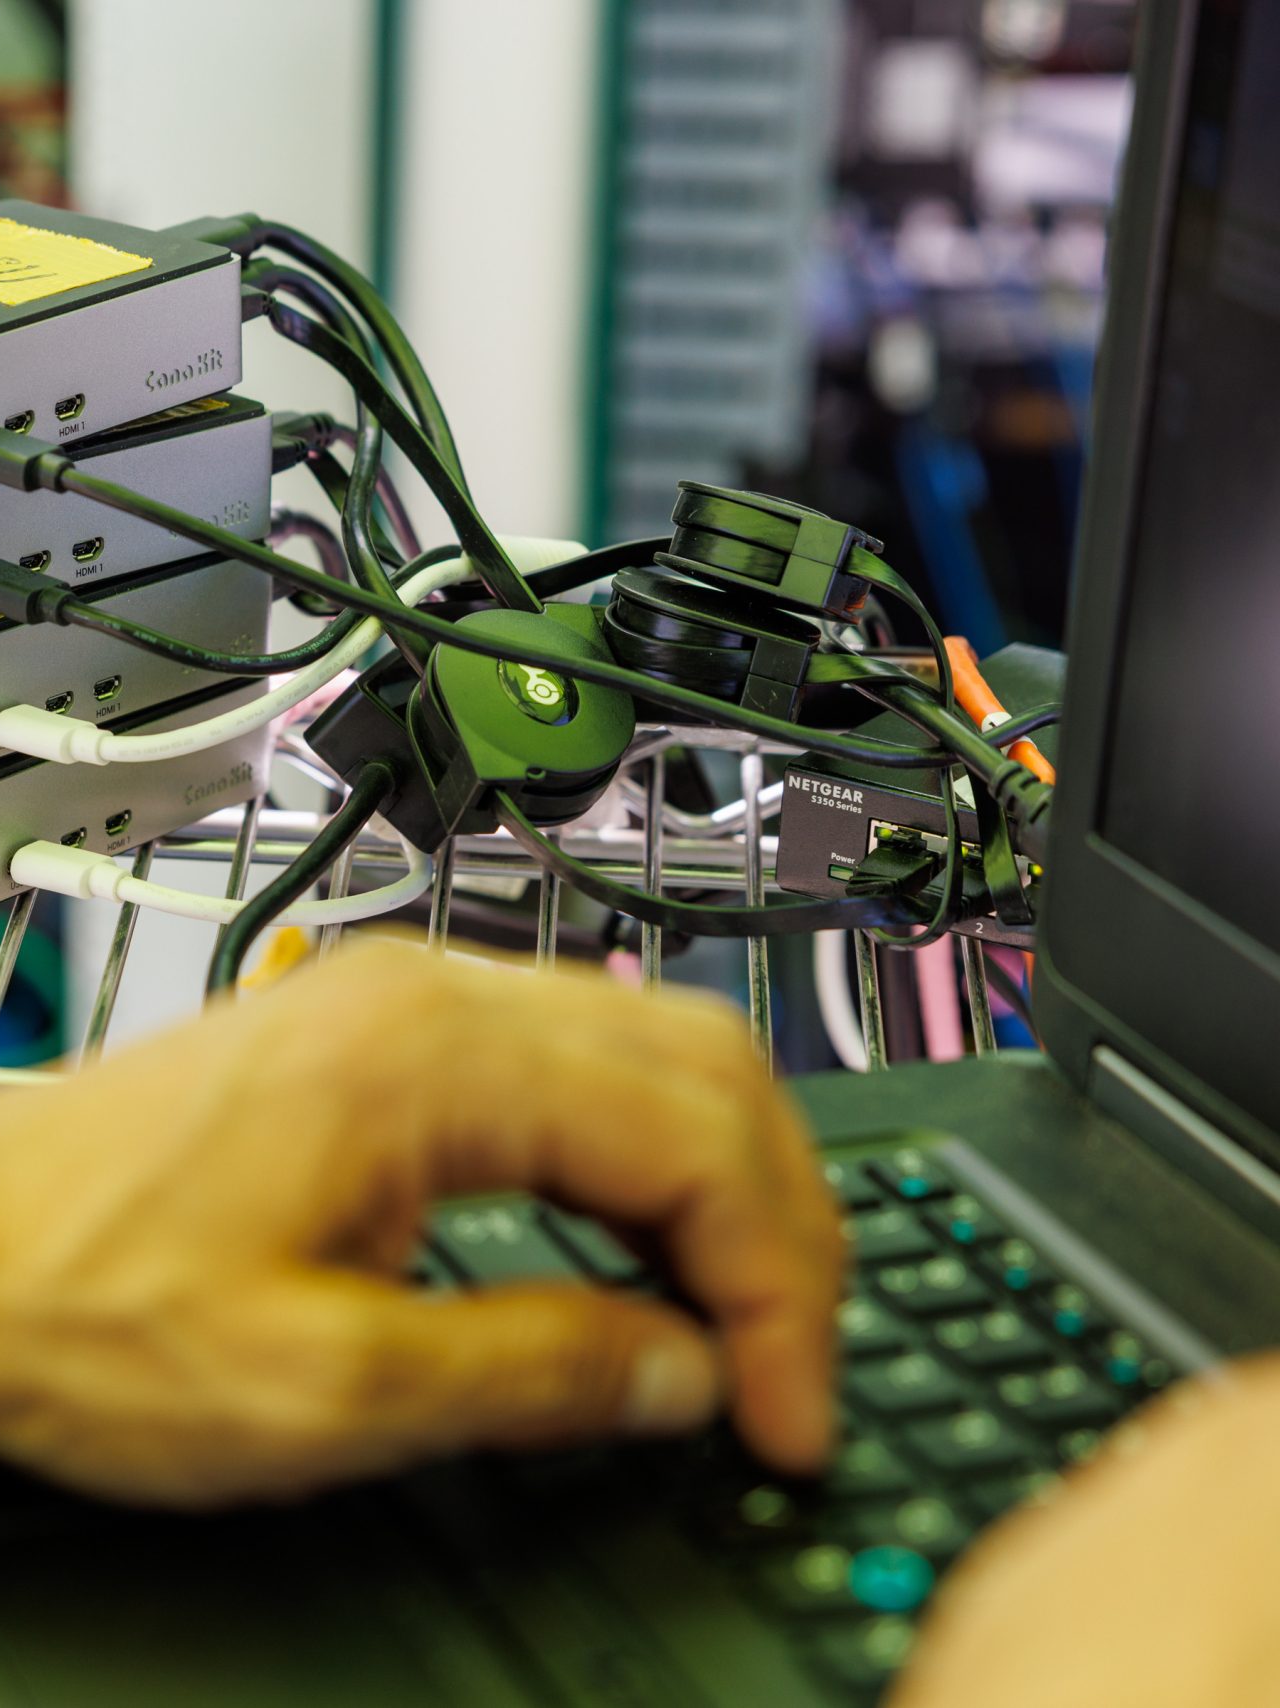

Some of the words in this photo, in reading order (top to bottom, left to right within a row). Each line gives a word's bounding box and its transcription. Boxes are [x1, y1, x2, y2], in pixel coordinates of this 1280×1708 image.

[59, 424, 80, 438] HDMI
[76, 565, 97, 578] HDMI
[99, 563, 104, 572] 1
[96, 705, 116, 719] HDMI
[788, 775, 864, 804] NETGEAR
[811, 795, 835, 808] S350
[836, 801, 862, 814] Series
[831, 852, 856, 864] Power
[975, 922, 984, 934] 2
